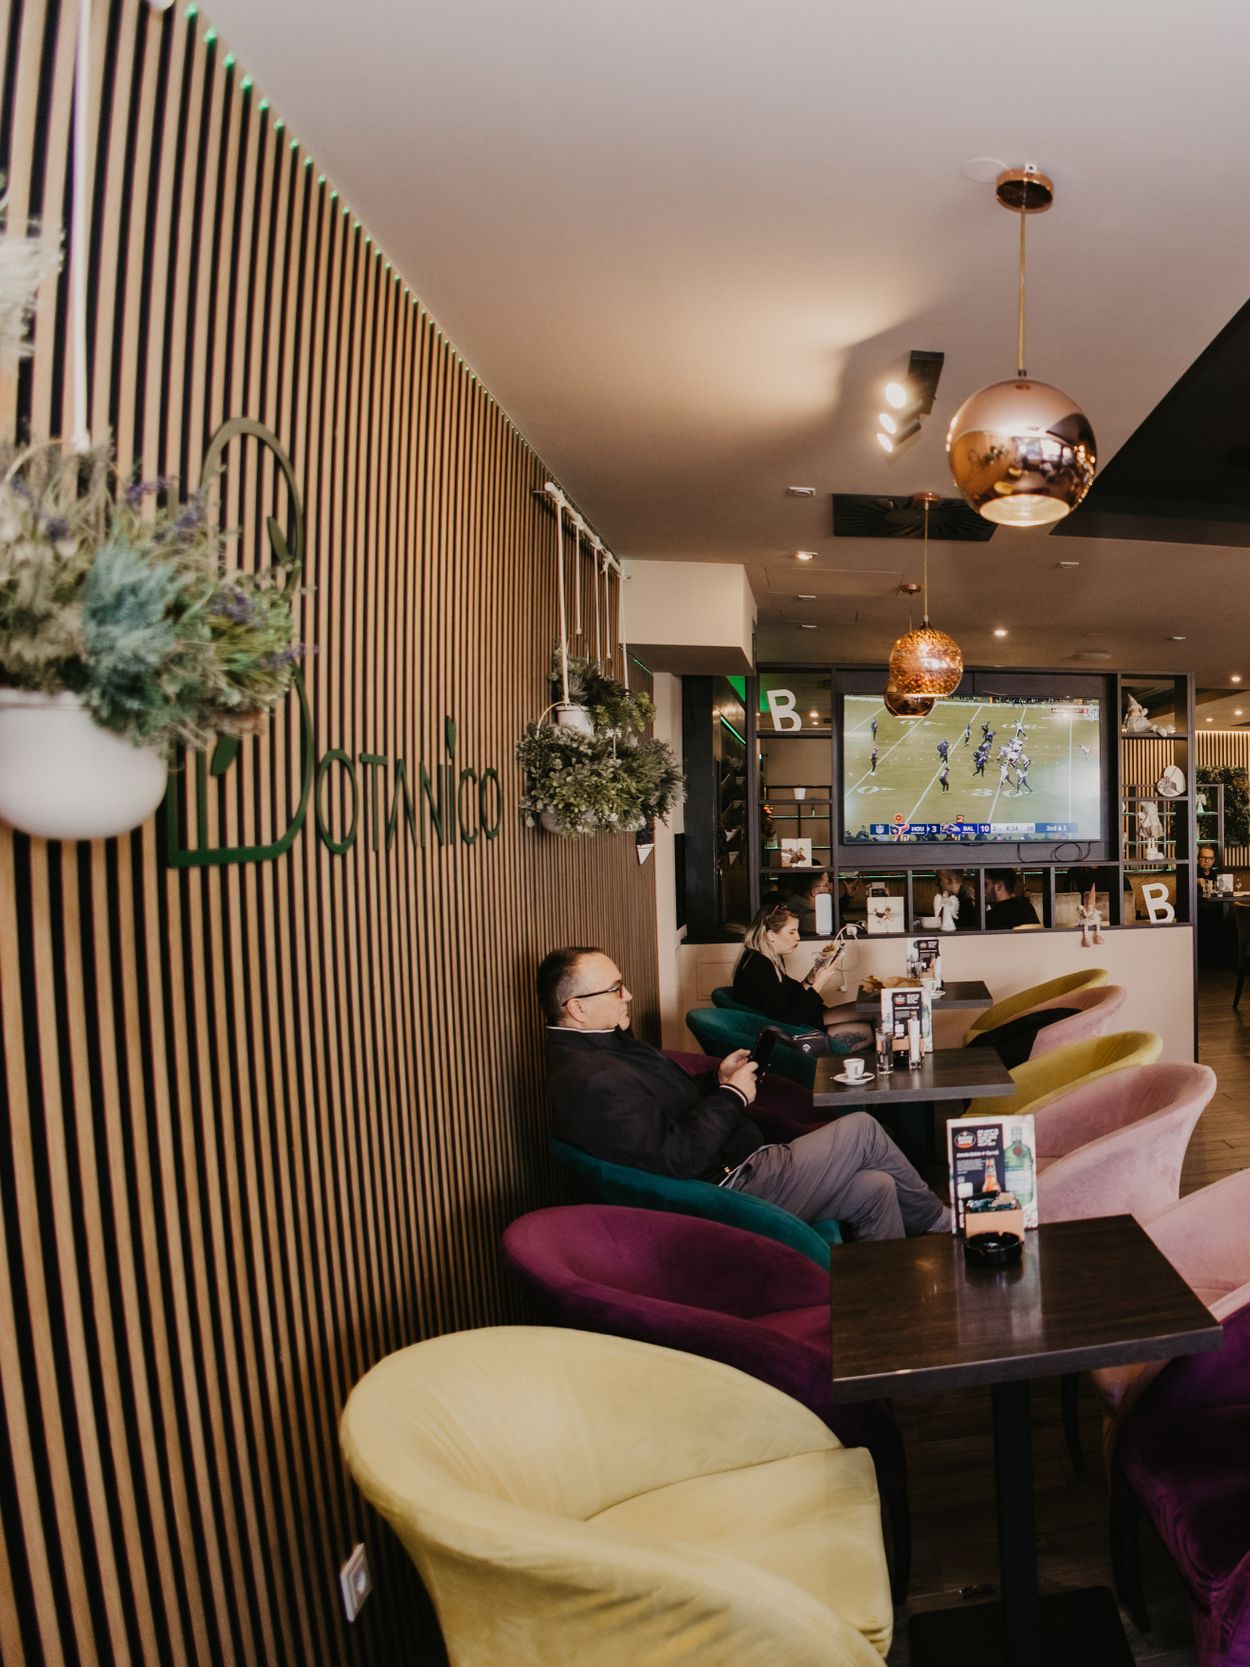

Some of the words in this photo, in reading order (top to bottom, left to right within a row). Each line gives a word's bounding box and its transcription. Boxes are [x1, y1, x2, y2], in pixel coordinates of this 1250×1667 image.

[767, 689, 802, 731] B
[931, 825, 937, 833] 3
[980, 825, 990, 833] 10
[1142, 883, 1175, 924] B
